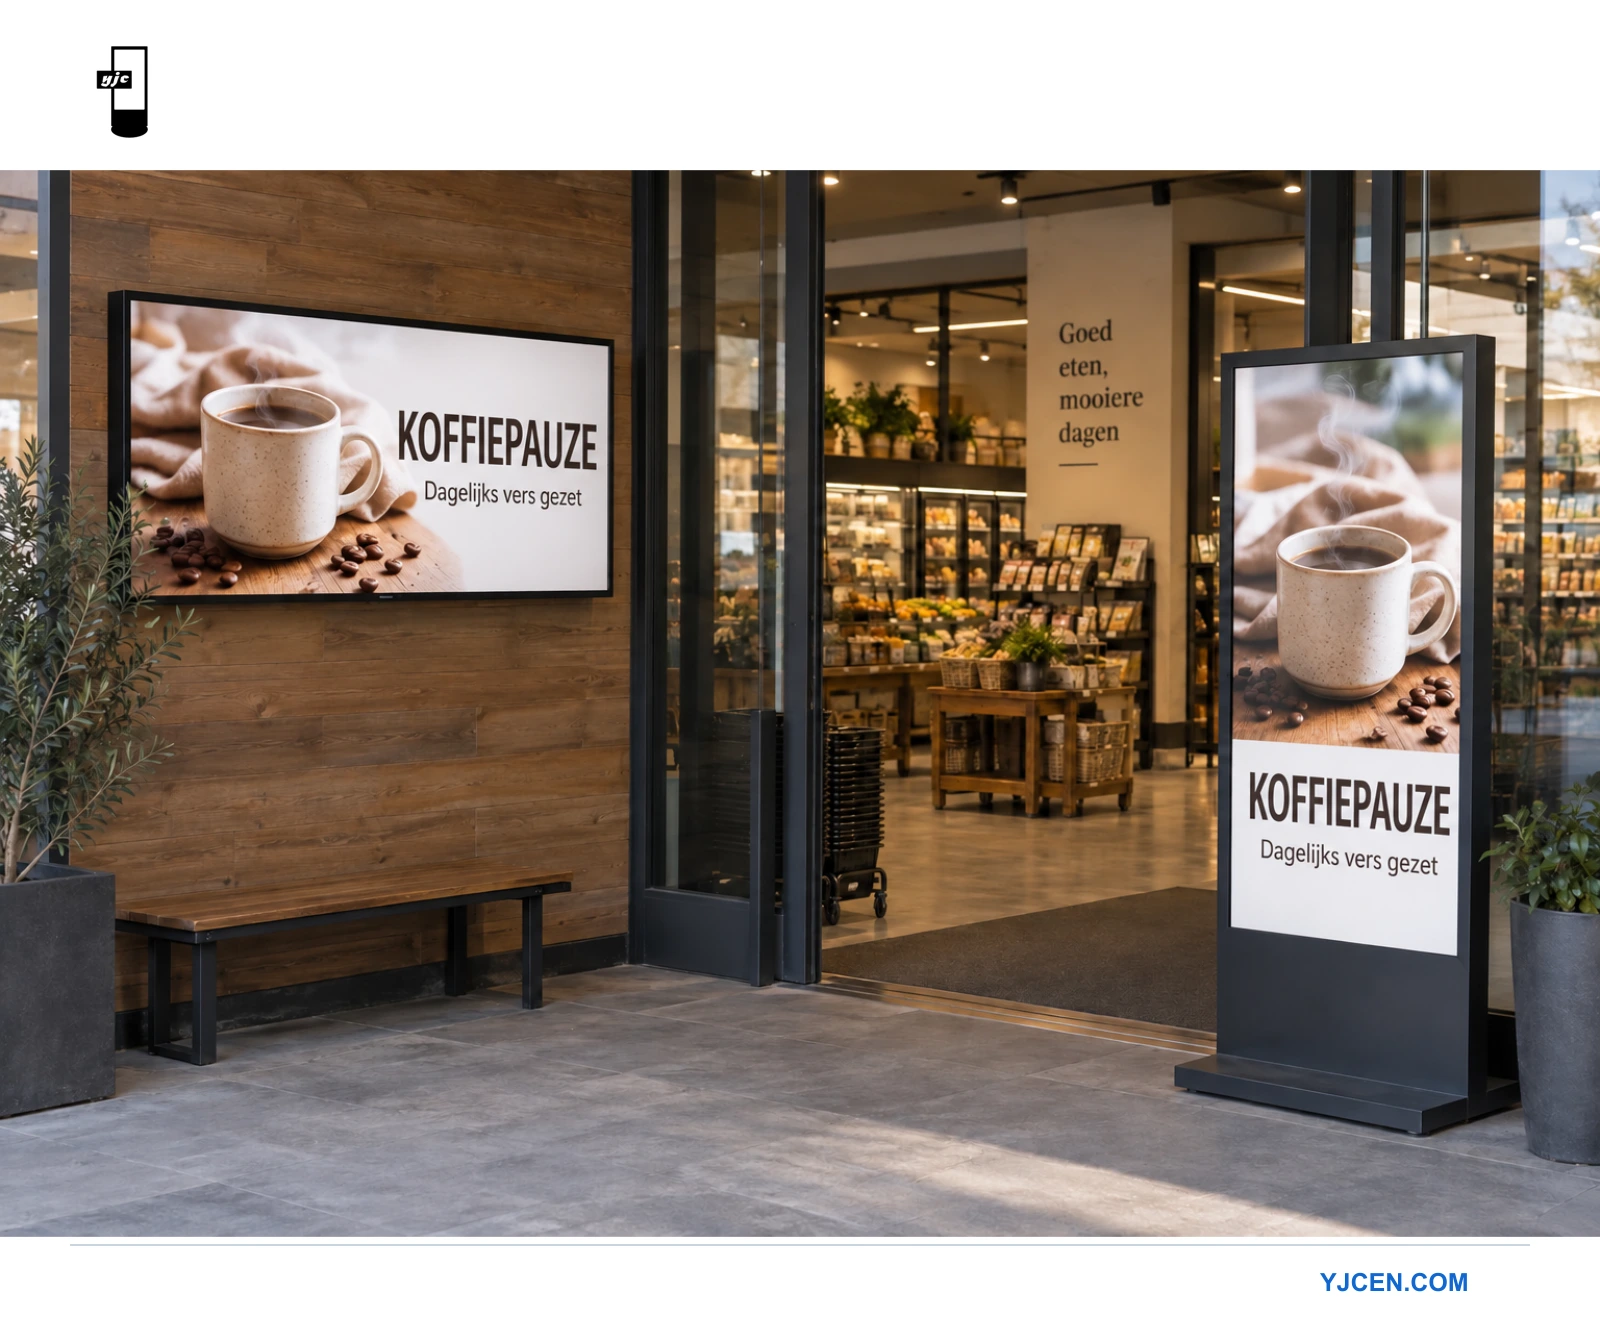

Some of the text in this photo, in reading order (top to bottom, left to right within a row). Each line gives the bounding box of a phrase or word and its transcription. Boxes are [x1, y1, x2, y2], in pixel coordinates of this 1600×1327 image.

[1058, 318, 1113, 345] Goed
[1058, 357, 1109, 379] eten,
[1058, 386, 1144, 411] mooiere
[398, 410, 598, 471] KOFFIEPAUZE
[1058, 421, 1120, 448] dagen
[424, 480, 582, 510] Dagelijks vers gezet
[1249, 771, 1451, 836] KOFFIEPAUZE
[1260, 838, 1439, 877] Dagelijks vers gezet
